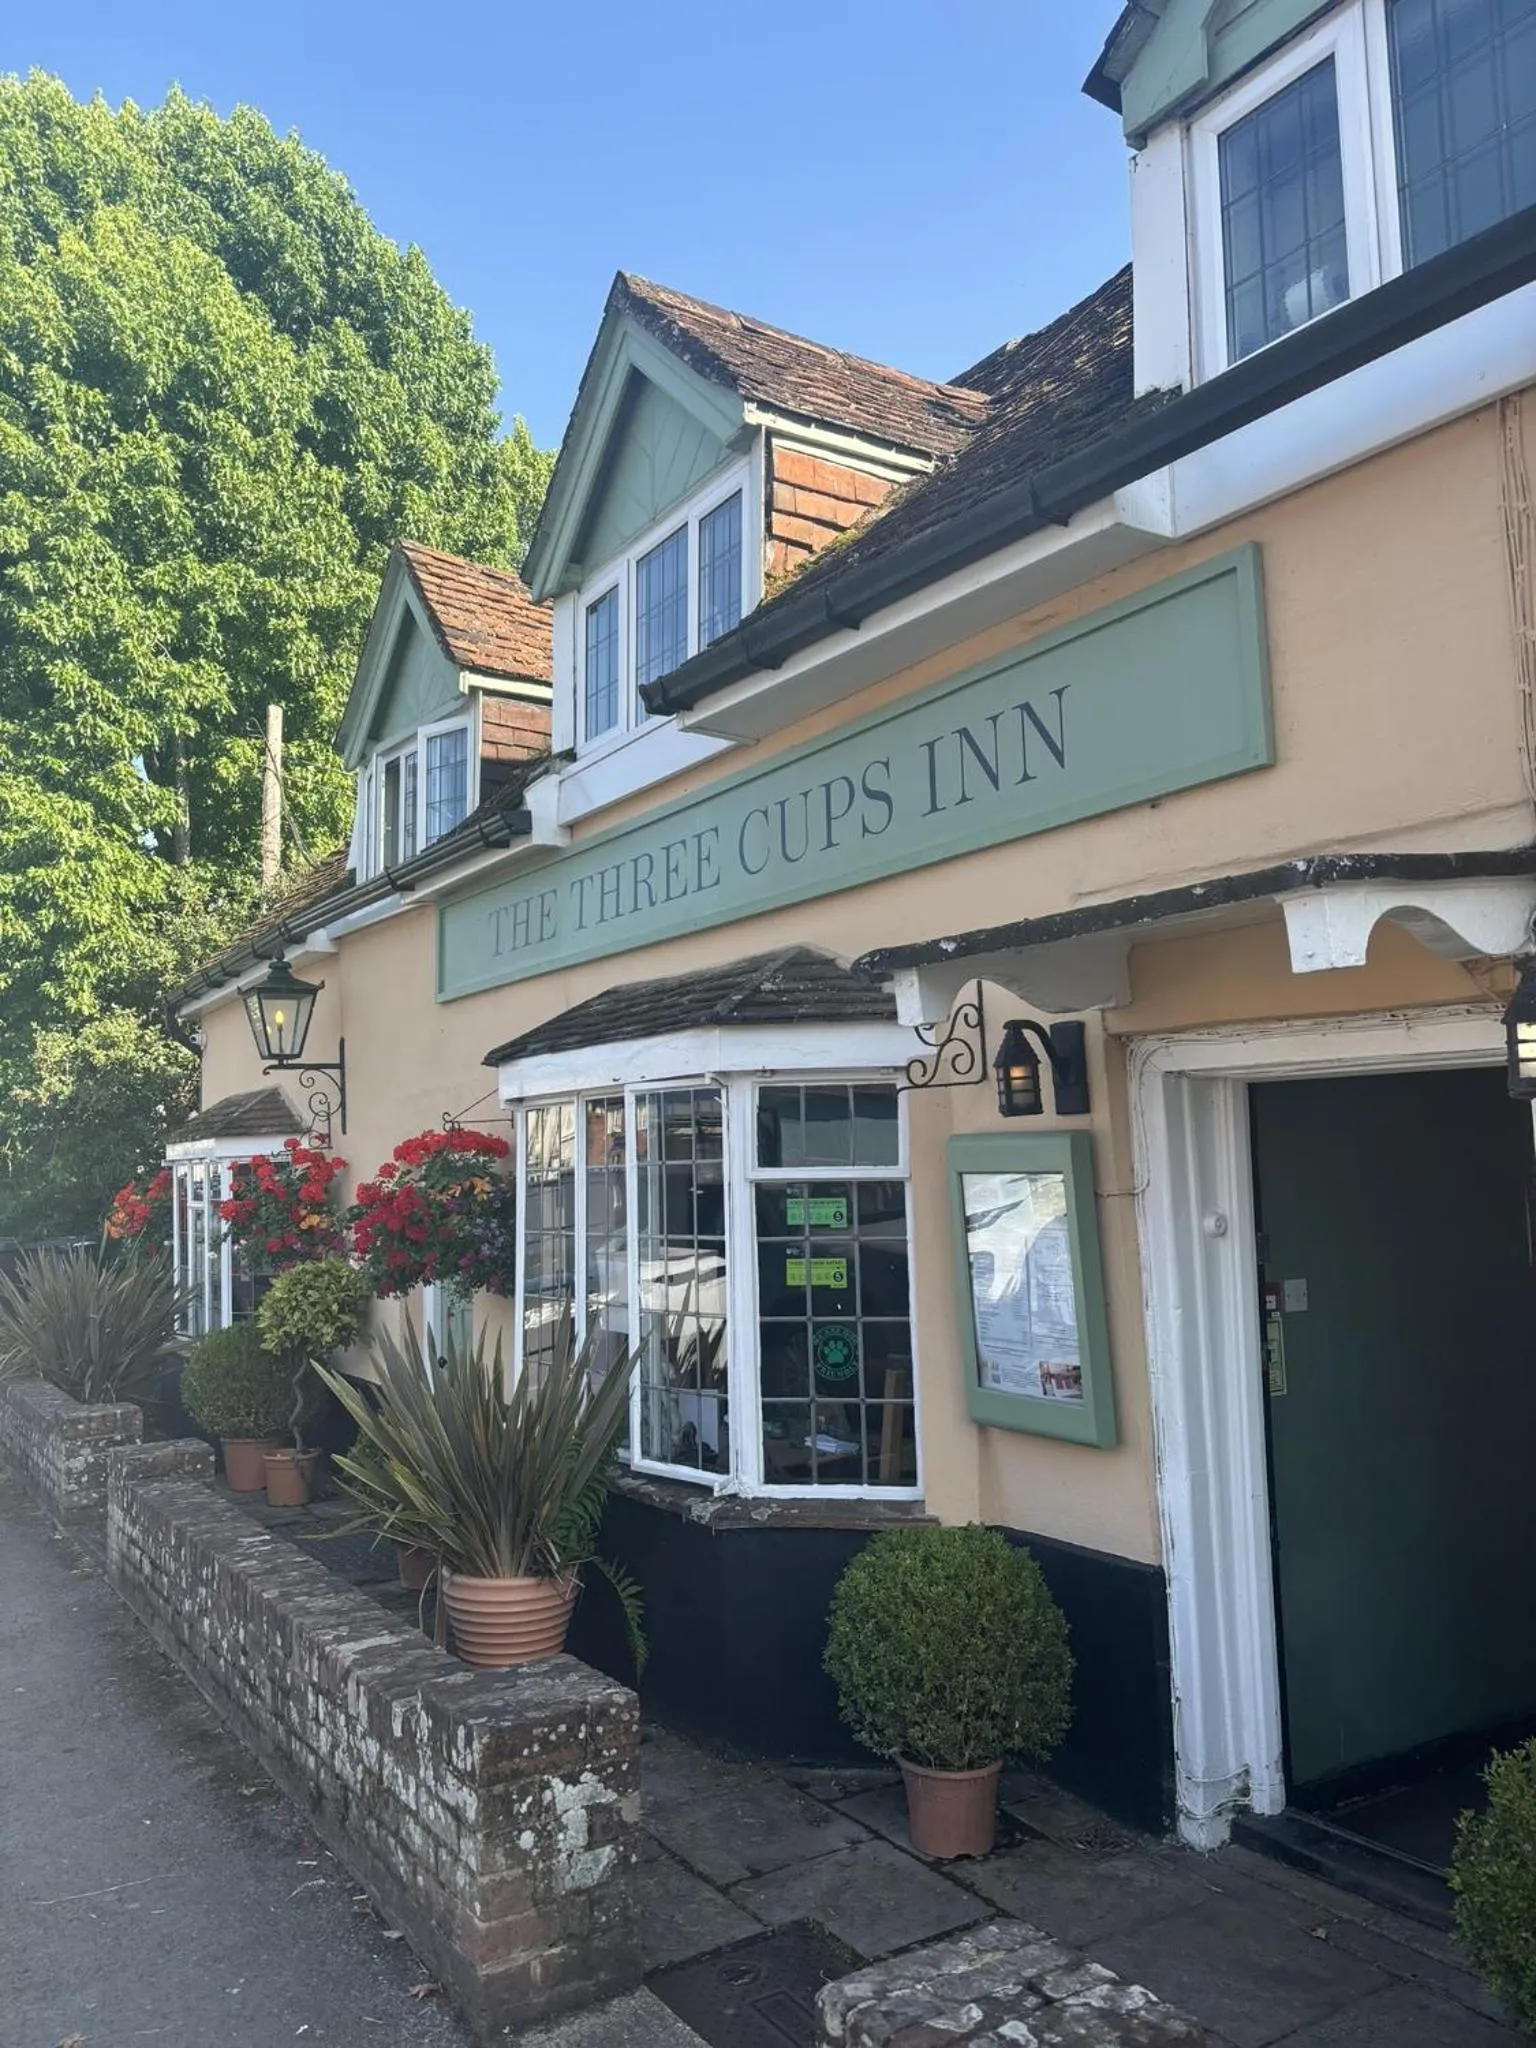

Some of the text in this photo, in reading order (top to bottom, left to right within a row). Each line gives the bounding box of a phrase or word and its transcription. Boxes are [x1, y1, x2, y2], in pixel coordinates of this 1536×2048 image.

[488, 685, 1070, 957] THE THREE CUPS INN
